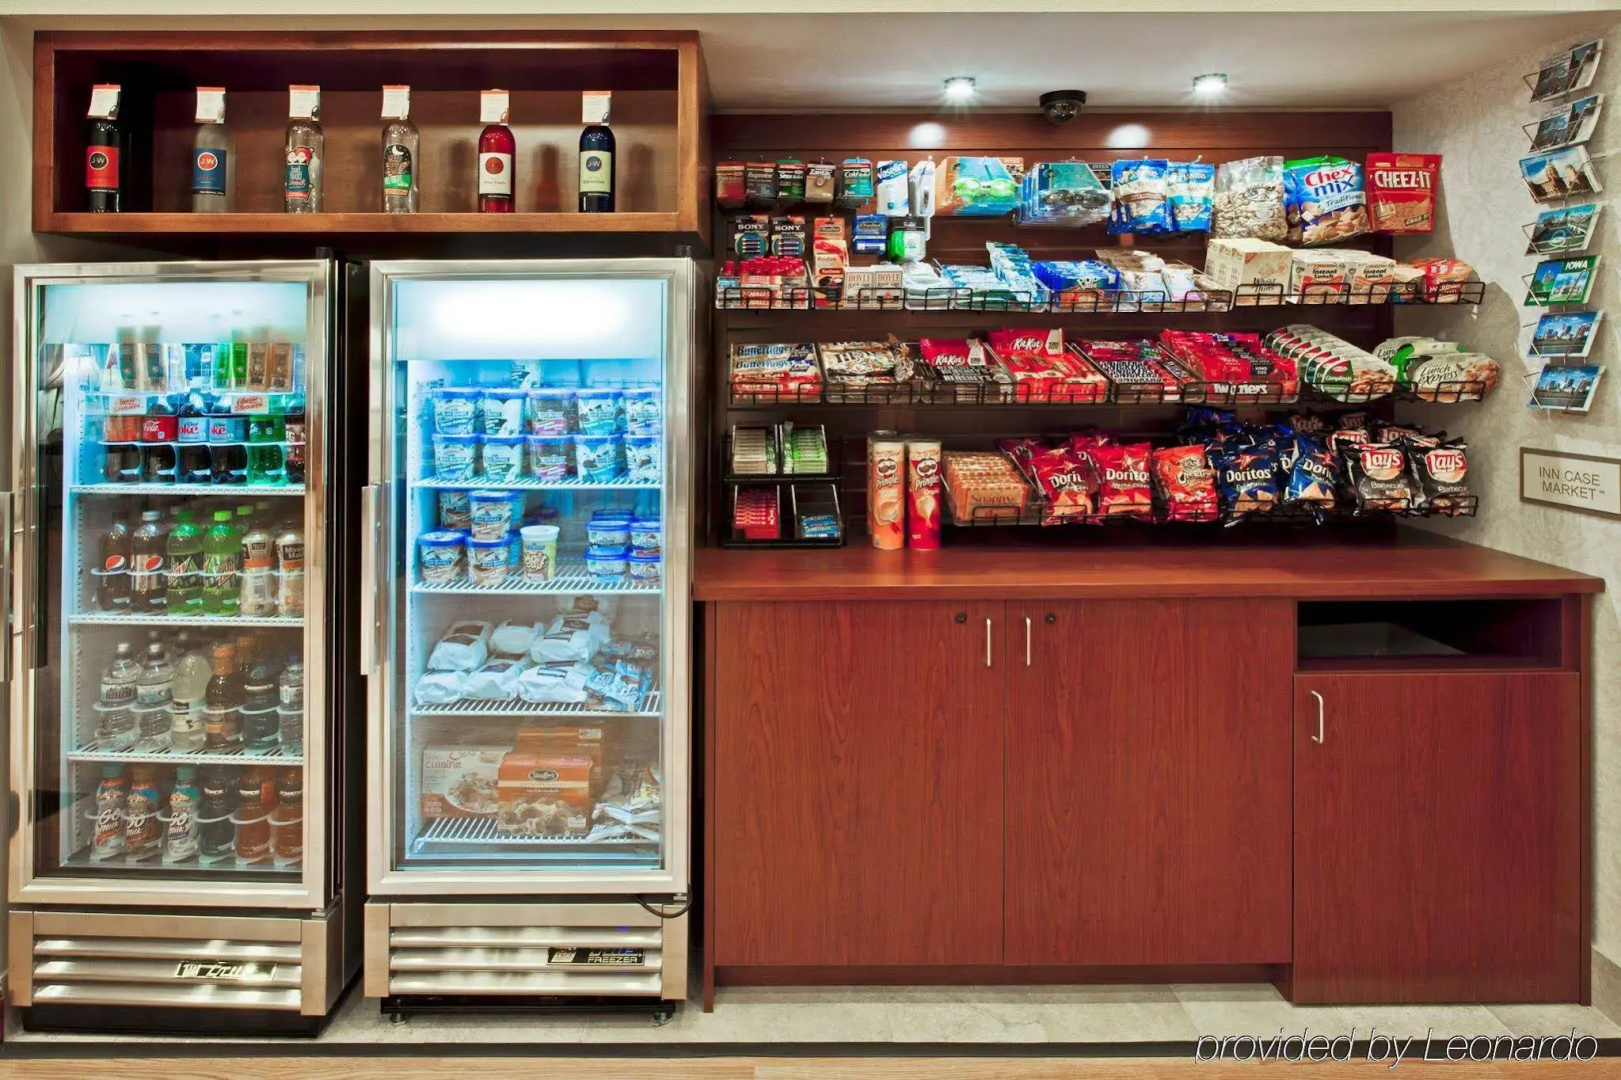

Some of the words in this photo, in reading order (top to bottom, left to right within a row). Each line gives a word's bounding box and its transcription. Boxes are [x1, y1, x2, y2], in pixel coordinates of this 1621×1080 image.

[1305, 167, 1353, 187] Chex
[1314, 180, 1355, 197] mix
[1326, 194, 1363, 206] Traditional
[1564, 259, 1588, 271] IOWA
[877, 271, 900, 281] HOYLE
[1420, 364, 1450, 376] Lunch
[1418, 370, 1459, 386] express
[1226, 467, 1272, 483] Doritos
[1539, 466, 1560, 480] INN
[1564, 470, 1600, 486] CASE
[425, 760, 462, 769] cuisine
